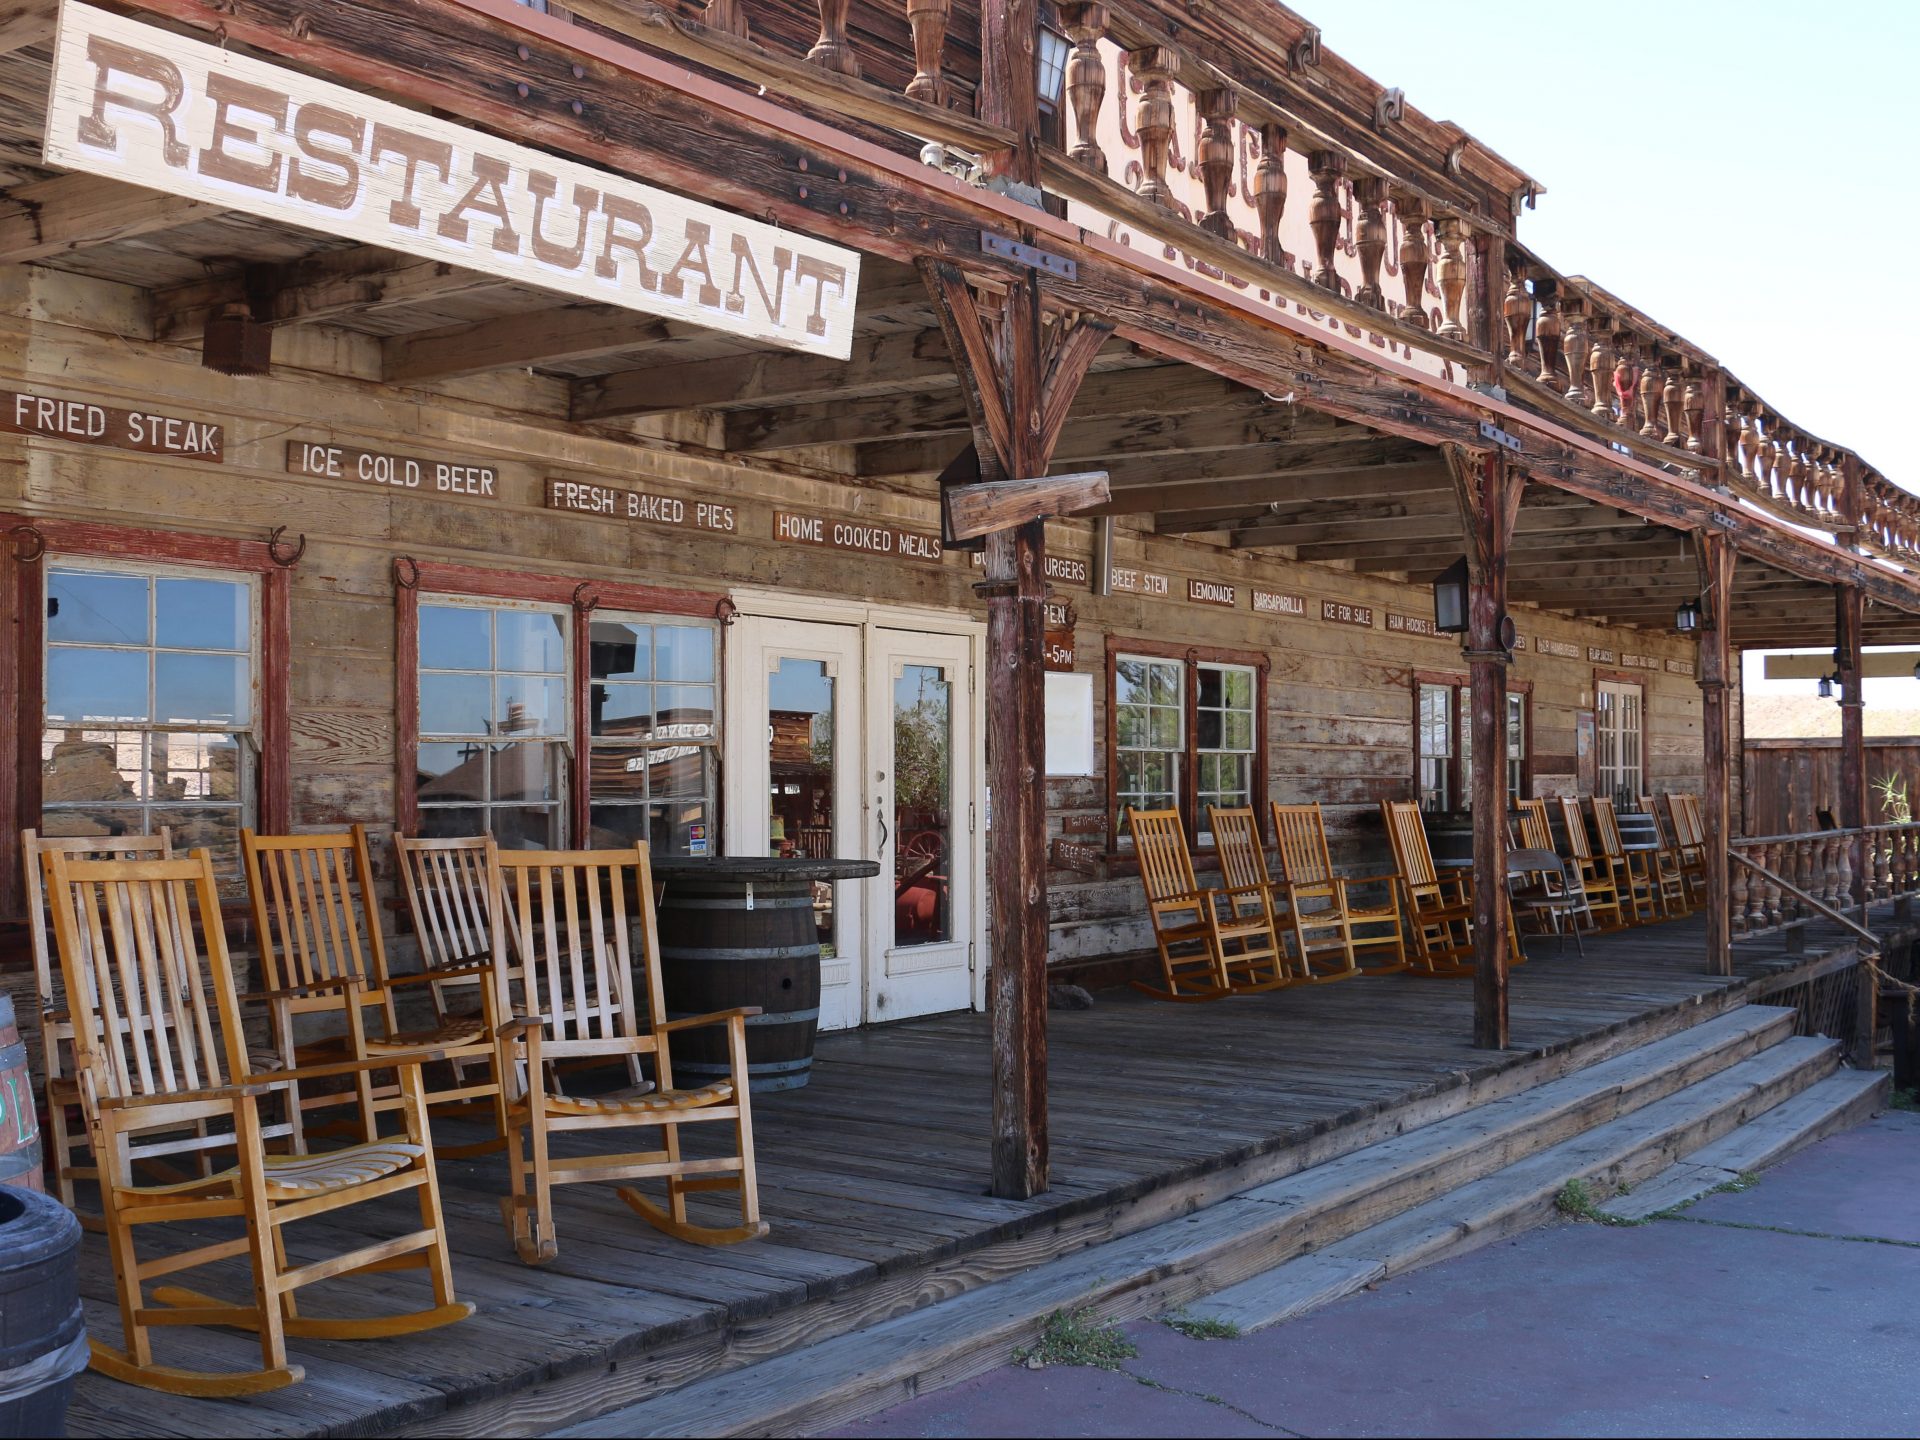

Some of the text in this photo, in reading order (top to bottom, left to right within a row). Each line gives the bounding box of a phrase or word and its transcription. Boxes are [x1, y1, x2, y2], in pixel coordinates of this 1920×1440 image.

[76, 35, 848, 338] RESTAURANT
[15, 393, 220, 456] FRIED STEAK
[302, 443, 495, 496] ICE COLD BEER
[552, 481, 735, 532] FRESH BAKED PIES
[778, 514, 825, 543] HOME
[833, 523, 892, 553] COOKED
[898, 532, 942, 560] MEALS
[1044, 556, 1086, 581] URGERS
[1110, 567, 1169, 595] BEEF STEW
[1189, 580, 1235, 605] LEMONADE
[1252, 590, 1304, 615] SARSAPARILLA
[1043, 604, 1067, 624] PEN
[1323, 602, 1371, 625] ICE FOR SALE
[1389, 614, 1404, 631] HAM
[1406, 617, 1426, 634] HOCKS
